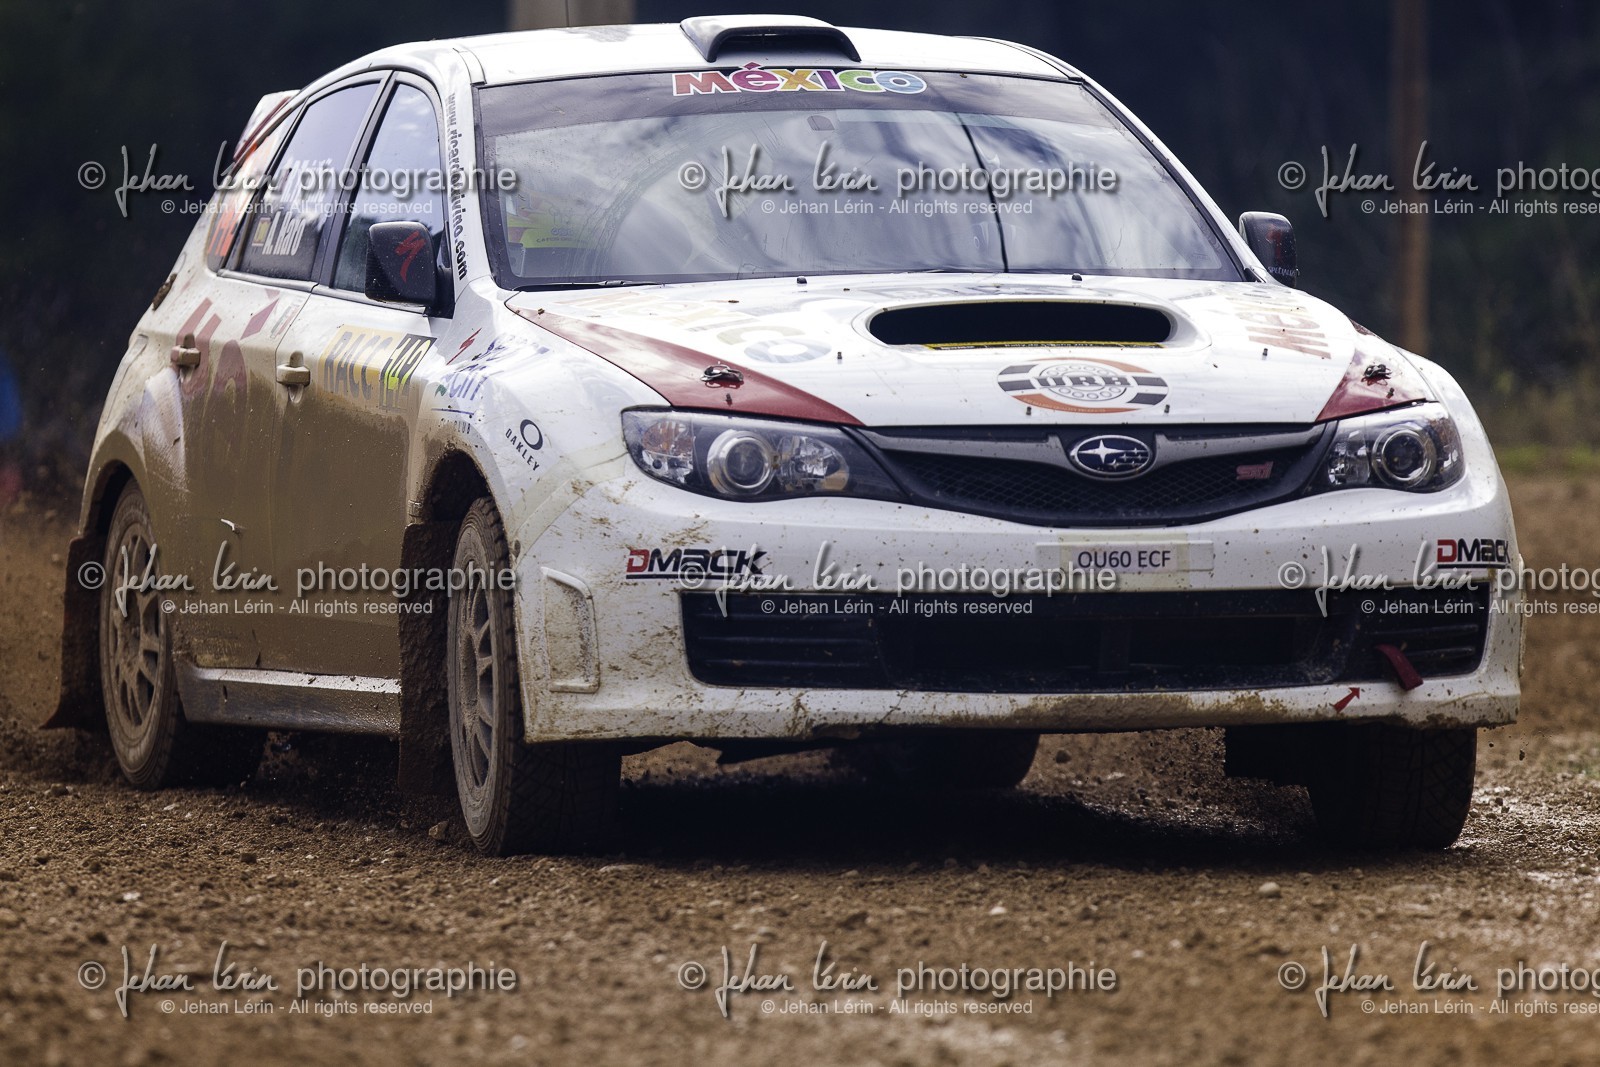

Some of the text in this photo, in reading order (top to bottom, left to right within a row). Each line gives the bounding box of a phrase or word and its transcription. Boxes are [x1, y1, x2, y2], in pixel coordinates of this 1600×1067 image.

[323, 331, 394, 401] RACC
[505, 428, 540, 471] OAKLEY
[1078, 551, 1171, 568] OU60 ECF
